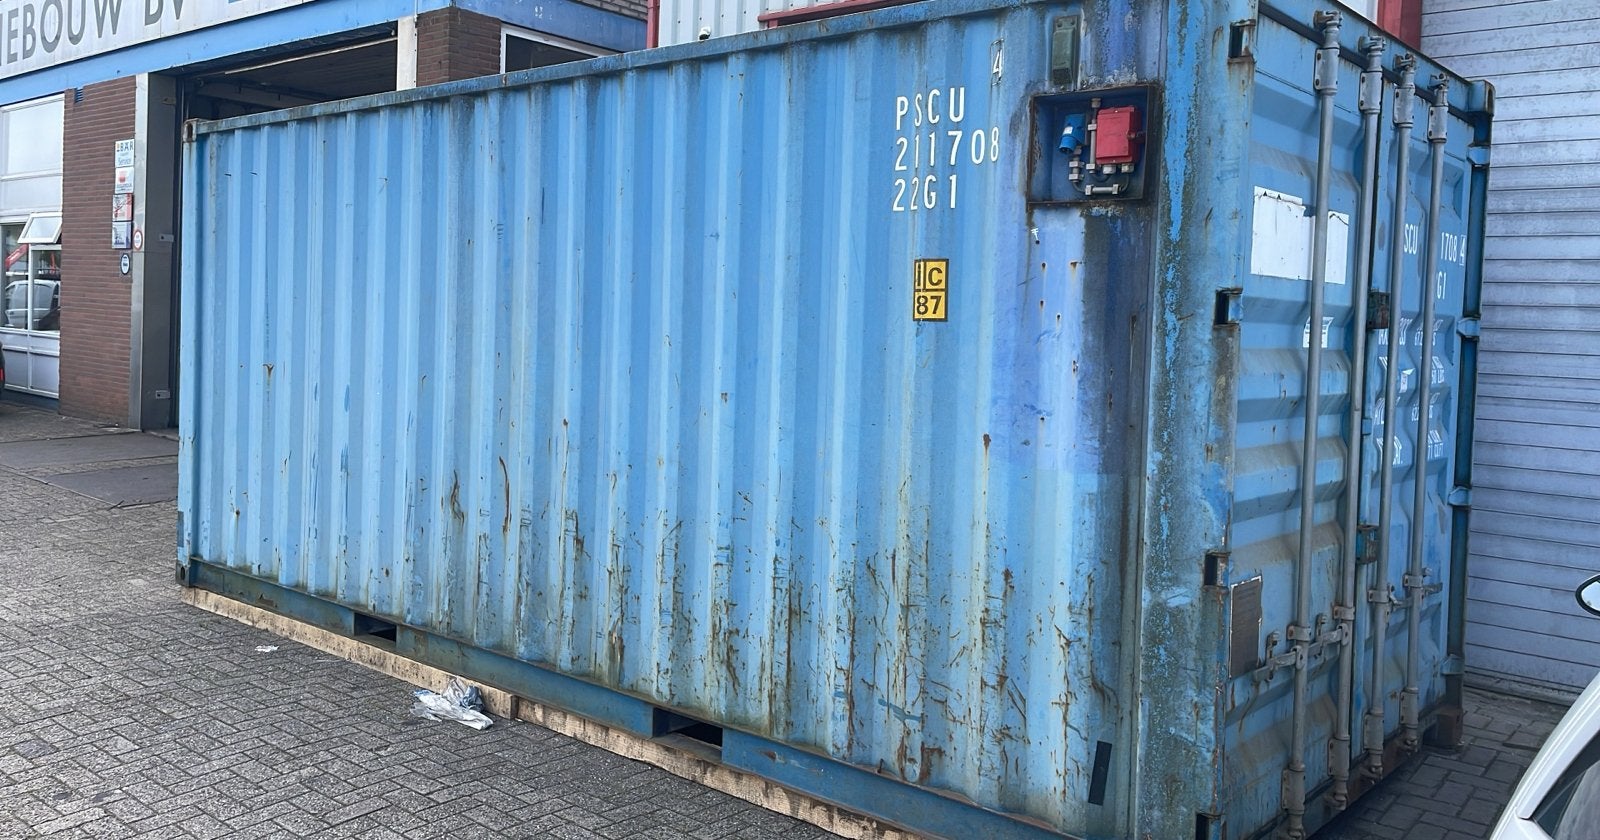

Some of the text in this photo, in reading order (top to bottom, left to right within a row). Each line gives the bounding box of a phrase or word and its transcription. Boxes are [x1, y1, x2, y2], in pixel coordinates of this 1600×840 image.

[993, 49, 1003, 79] 4
[896, 87, 965, 131] PSCU
[895, 127, 999, 171] 211708
[893, 175, 957, 212] 22G1
[916, 295, 942, 316] 87
